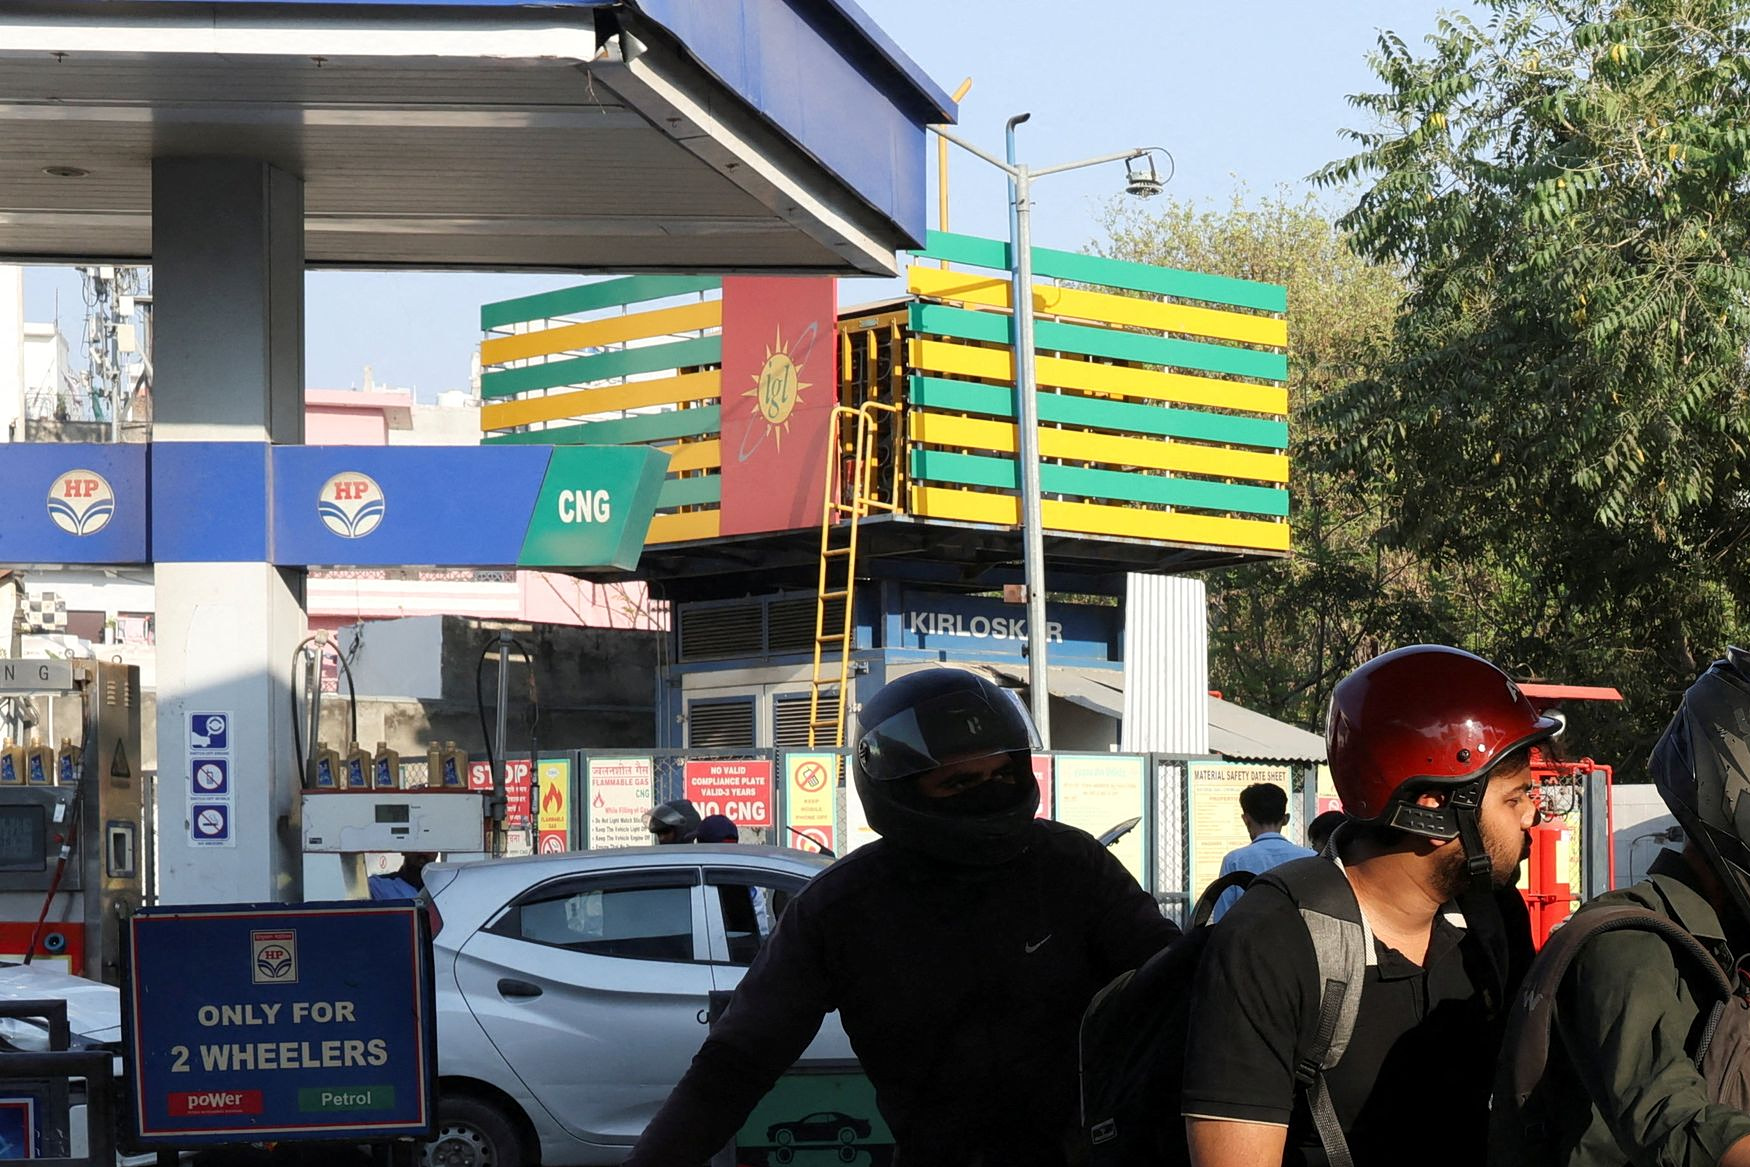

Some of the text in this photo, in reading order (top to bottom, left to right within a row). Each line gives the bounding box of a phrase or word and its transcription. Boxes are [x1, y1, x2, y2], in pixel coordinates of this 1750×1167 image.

[63, 478, 99, 498] HP
[334, 481, 369, 500] HP
[558, 488, 611, 524] CNG
[910, 611, 1063, 644] KIRLOSKR
[710, 766, 746, 775] NO VALID
[1194, 770, 1225, 780] MATERIAL
[1226, 771, 1250, 781] SAFETY
[1267, 771, 1287, 781] SHEET
[634, 778, 649, 786] GAS
[691, 777, 765, 786] COMPLIANCE PLATE
[635, 789, 650, 798] CNG
[731, 788, 756, 796] YEARS
[725, 801, 766, 821] CNG
[264, 950, 284, 960] HP
[197, 1001, 356, 1028] ONLY FOR
[170, 1038, 388, 1073] 2 WHEELERS
[321, 1091, 373, 1107] Petrol
